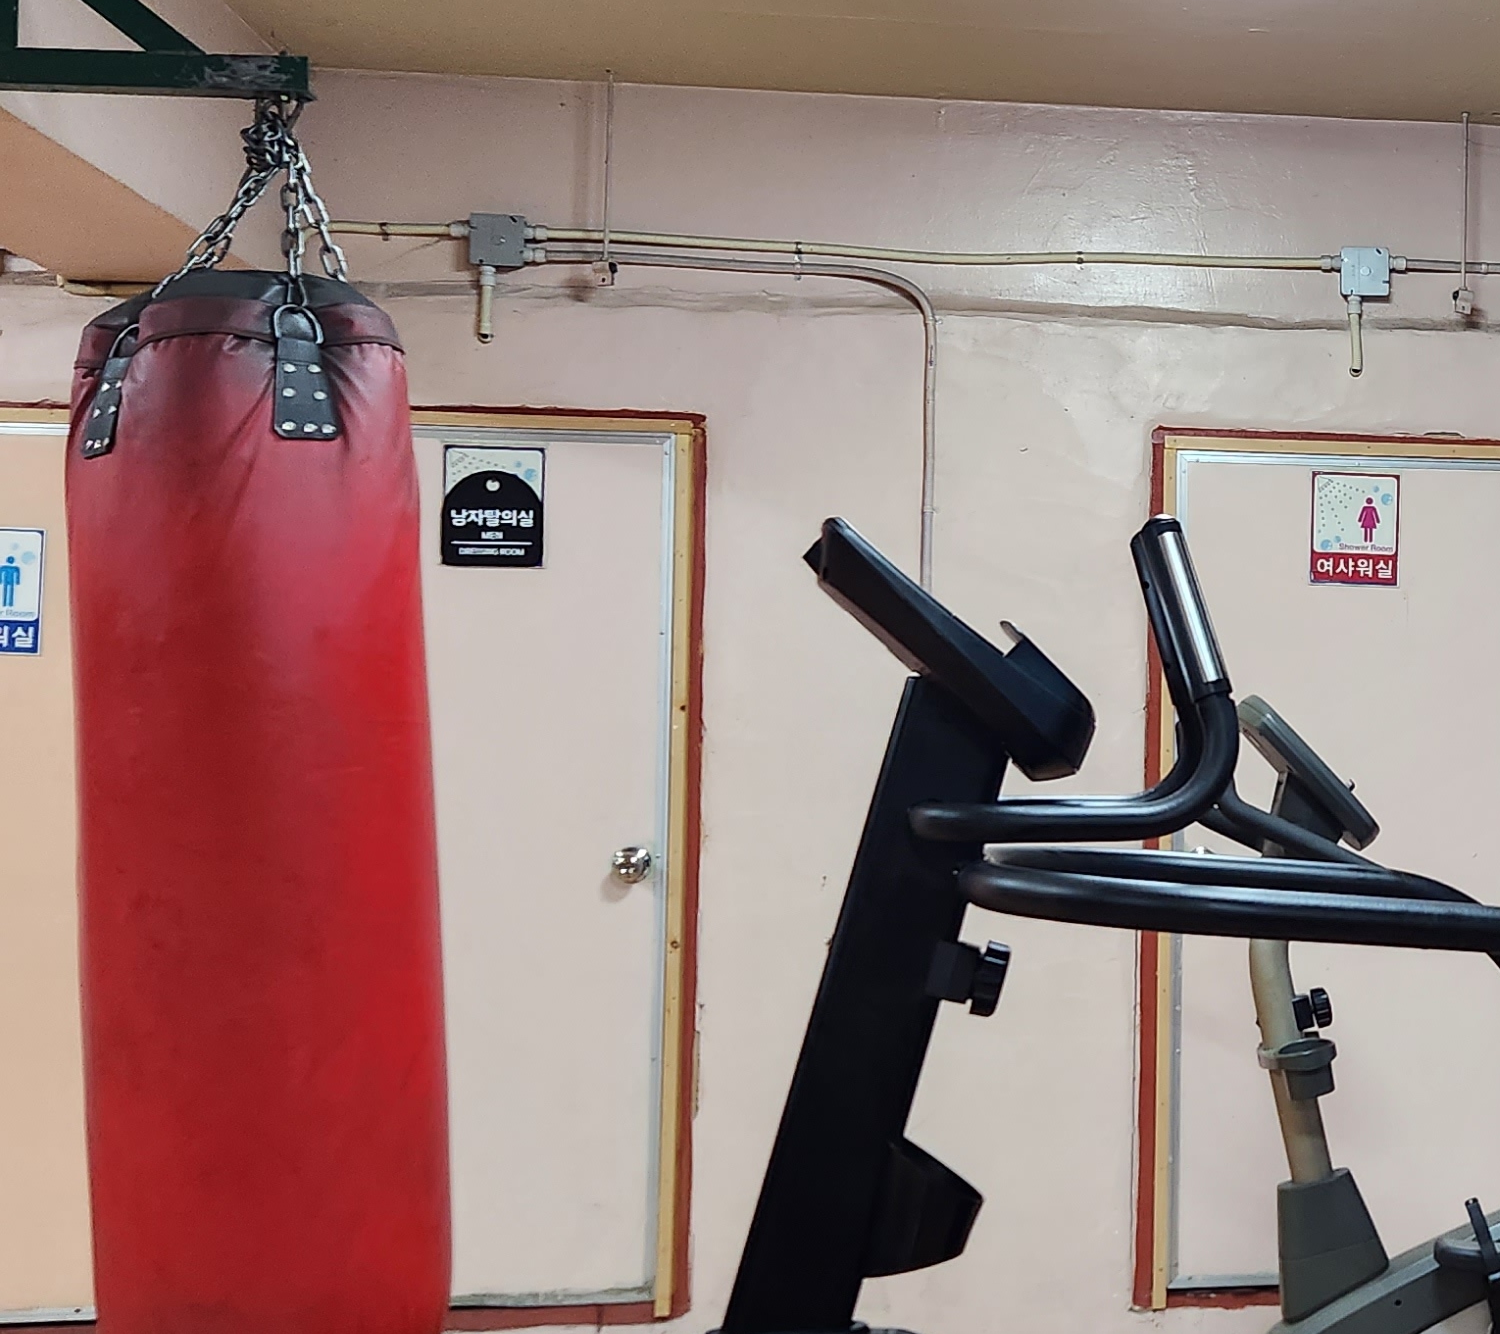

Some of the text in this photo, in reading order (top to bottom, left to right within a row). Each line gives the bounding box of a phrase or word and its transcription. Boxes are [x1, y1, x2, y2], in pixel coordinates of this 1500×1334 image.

[1338, 542, 1394, 553] Shower Room
[1316, 557, 1394, 579] 여샤워실
